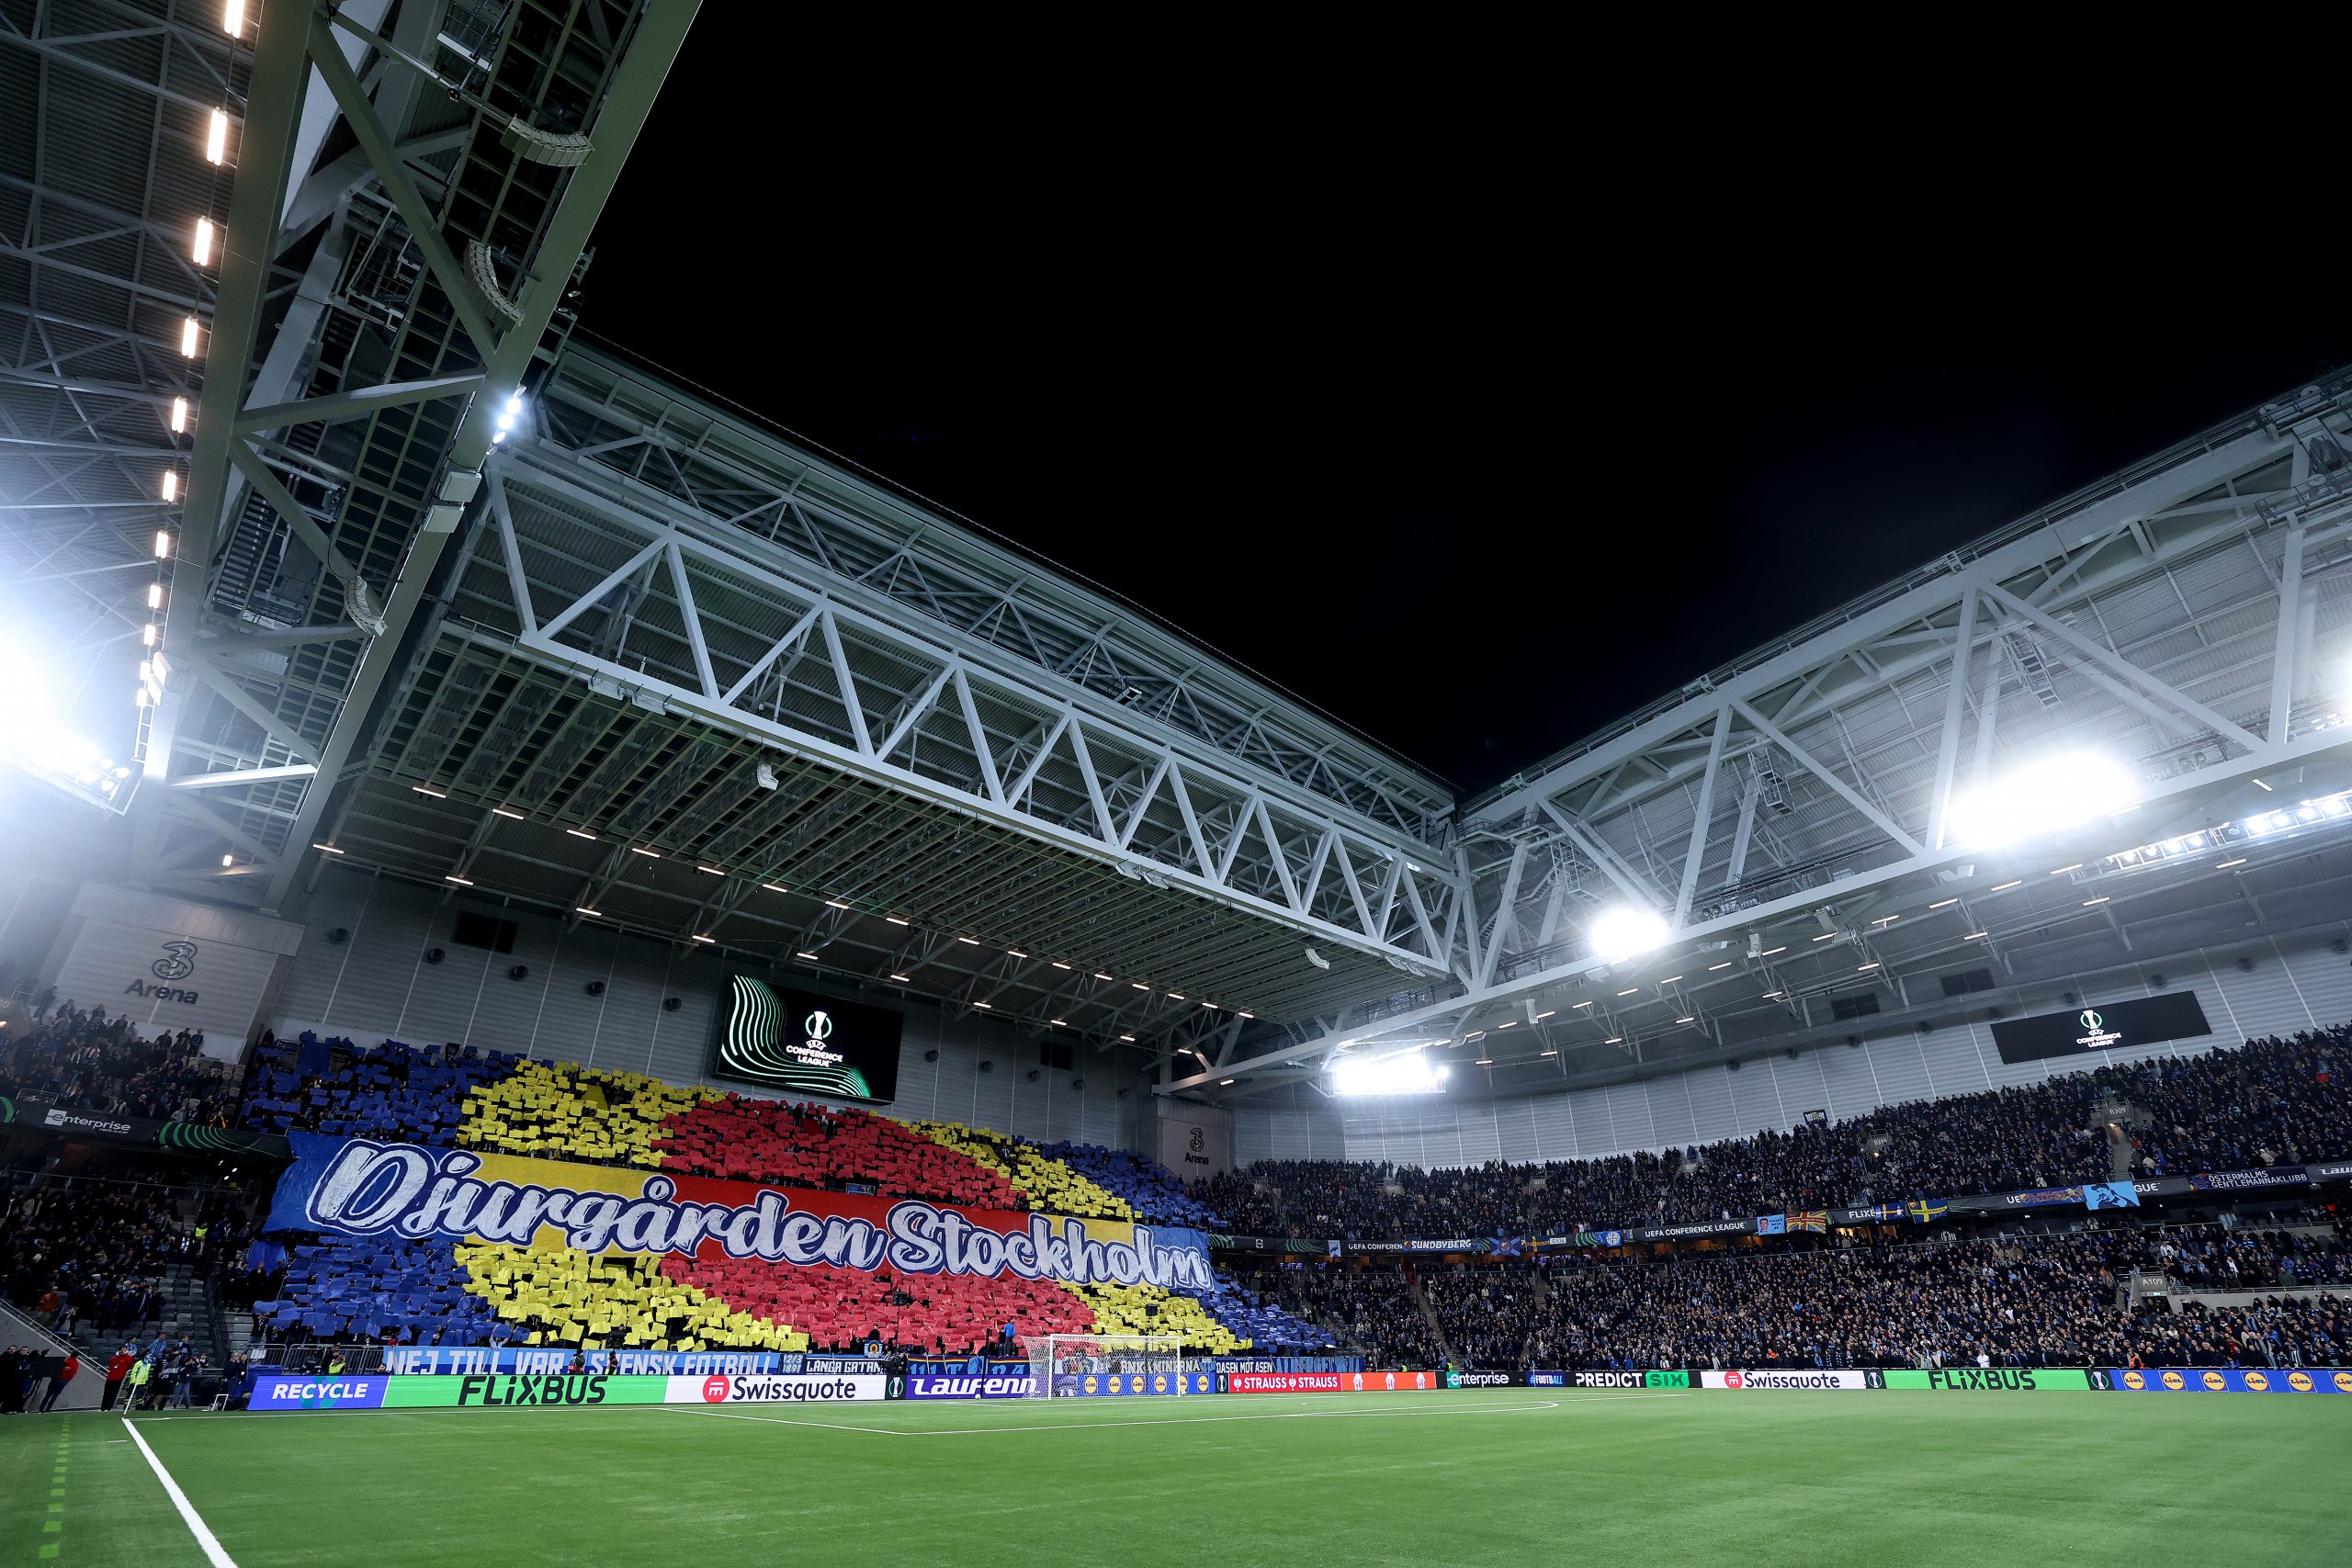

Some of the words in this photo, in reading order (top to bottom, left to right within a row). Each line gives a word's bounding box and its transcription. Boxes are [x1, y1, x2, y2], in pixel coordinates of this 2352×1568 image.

[124, 979, 198, 1005] Arena
[786, 1045, 843, 1062] CONFERENCE
[797, 1055, 830, 1067] LEAGUE
[50, 1113, 130, 1131] enterprise
[1184, 1152, 1209, 1165] Arena
[2208, 1170, 2268, 1182] ÖSTERMALMS
[2318, 1167, 2352, 1175] Lau
[2133, 1183, 2159, 1192] GUE
[2211, 1174, 2307, 1188] GENTLEMANNAKLUBB
[2006, 1196, 2020, 1204] UE
[307, 1139, 888, 1271] Djurgården
[888, 1200, 1214, 1290] Stockholm
[1666, 1224, 1713, 1236] CONFERENCE
[1714, 1222, 1745, 1232] LEAGUE
[1411, 1239, 1472, 1249] SUNDBYBERG
[2143, 1278, 2163, 1286] A109
[386, 1350, 439, 1375] NEJ
[449, 1350, 503, 1375] TILL
[515, 1351, 565, 1375] VAR
[1244, 1377, 1286, 1389] STRAUSS
[1298, 1376, 1338, 1389] STRAUSS
[1448, 1371, 1510, 1388] enterprise
[1530, 1374, 1563, 1384] #FOOTBALL
[1576, 1372, 1643, 1387] PREDICT
[1650, 1373, 1685, 1387] SIX
[1744, 1372, 1840, 1389] Swissquote
[272, 1382, 368, 1400] RECYCLE
[732, 1376, 856, 1402] Swissquote
[911, 1378, 1040, 1395] Laufenn
